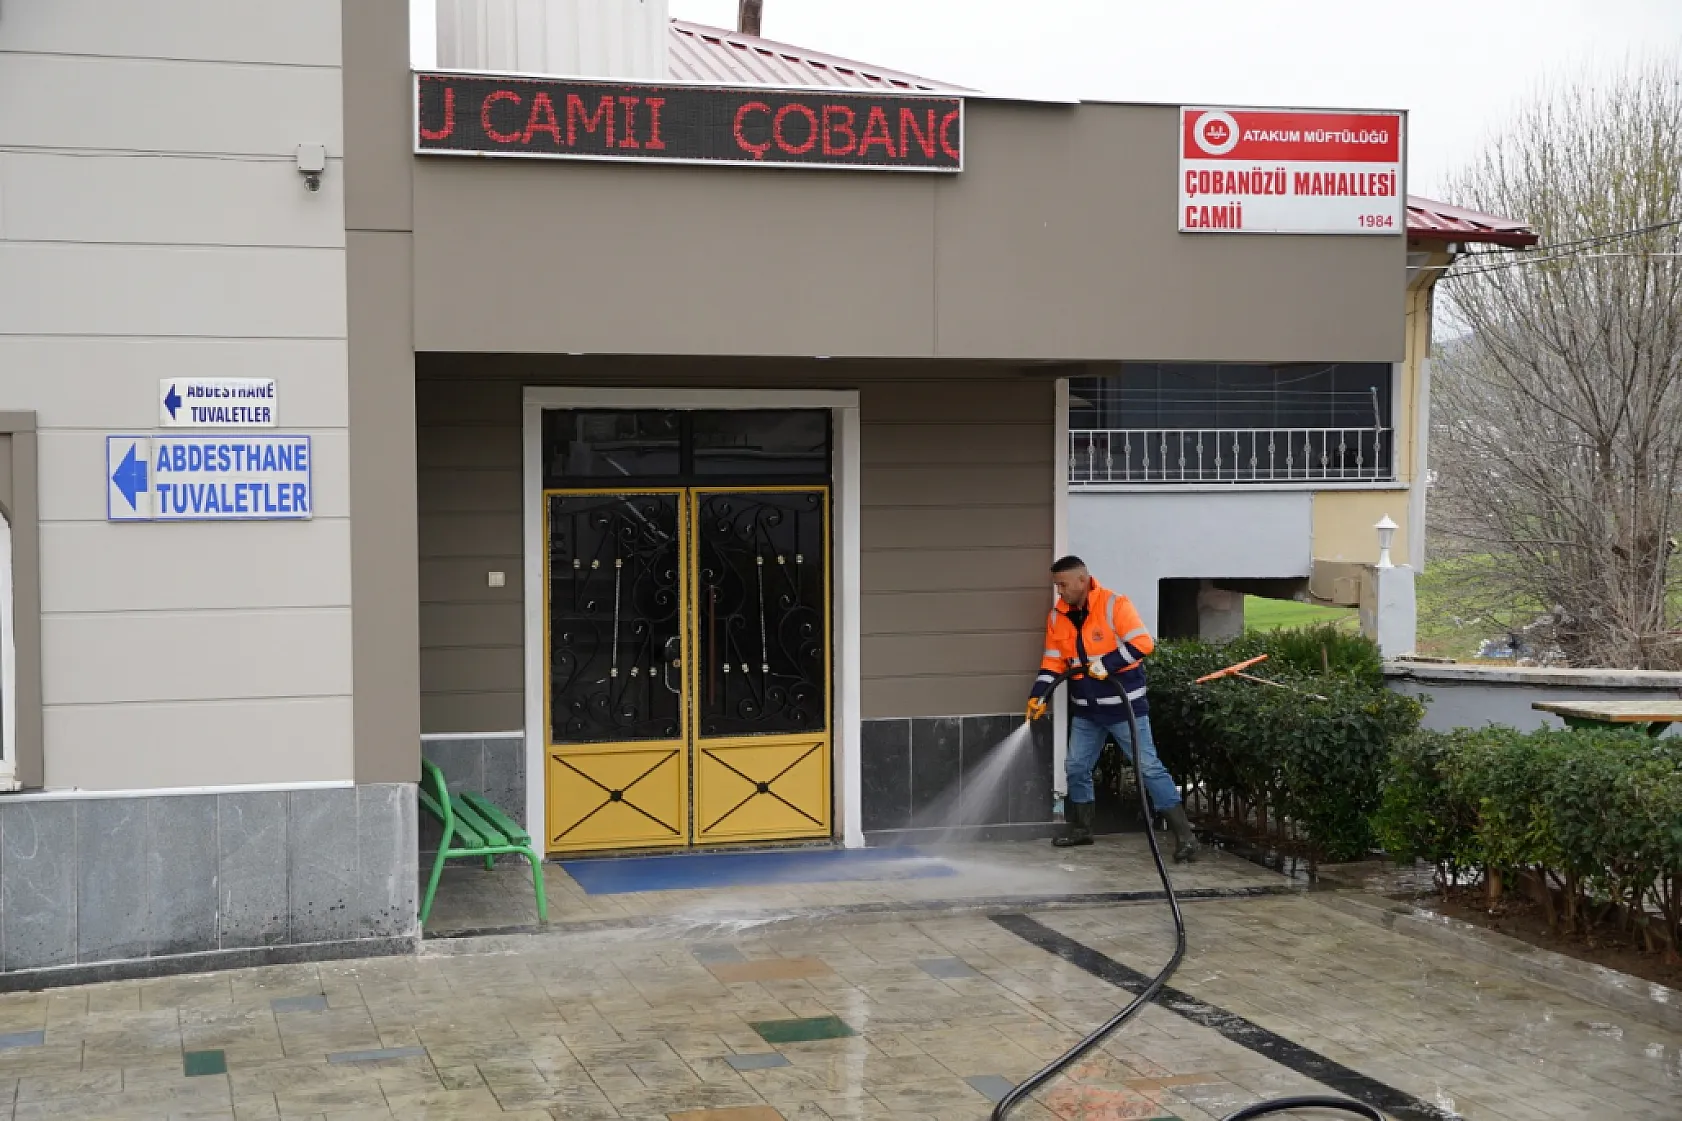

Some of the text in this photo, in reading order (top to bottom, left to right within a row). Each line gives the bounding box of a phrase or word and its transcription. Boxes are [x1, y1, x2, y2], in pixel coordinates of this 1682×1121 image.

[1243, 128, 1389, 144] ATAKUM MÜFTÜLÜĞÜ
[1185, 167, 1397, 198] ÇOBANÖZÜ MAHALLESİ
[1185, 201, 1242, 229] CAMİİ
[1357, 214, 1394, 228] 1984
[191, 406, 271, 423] TUVALETLER
[156, 444, 307, 472] ABDESTHANE
[156, 483, 308, 514] TUVALETLER
